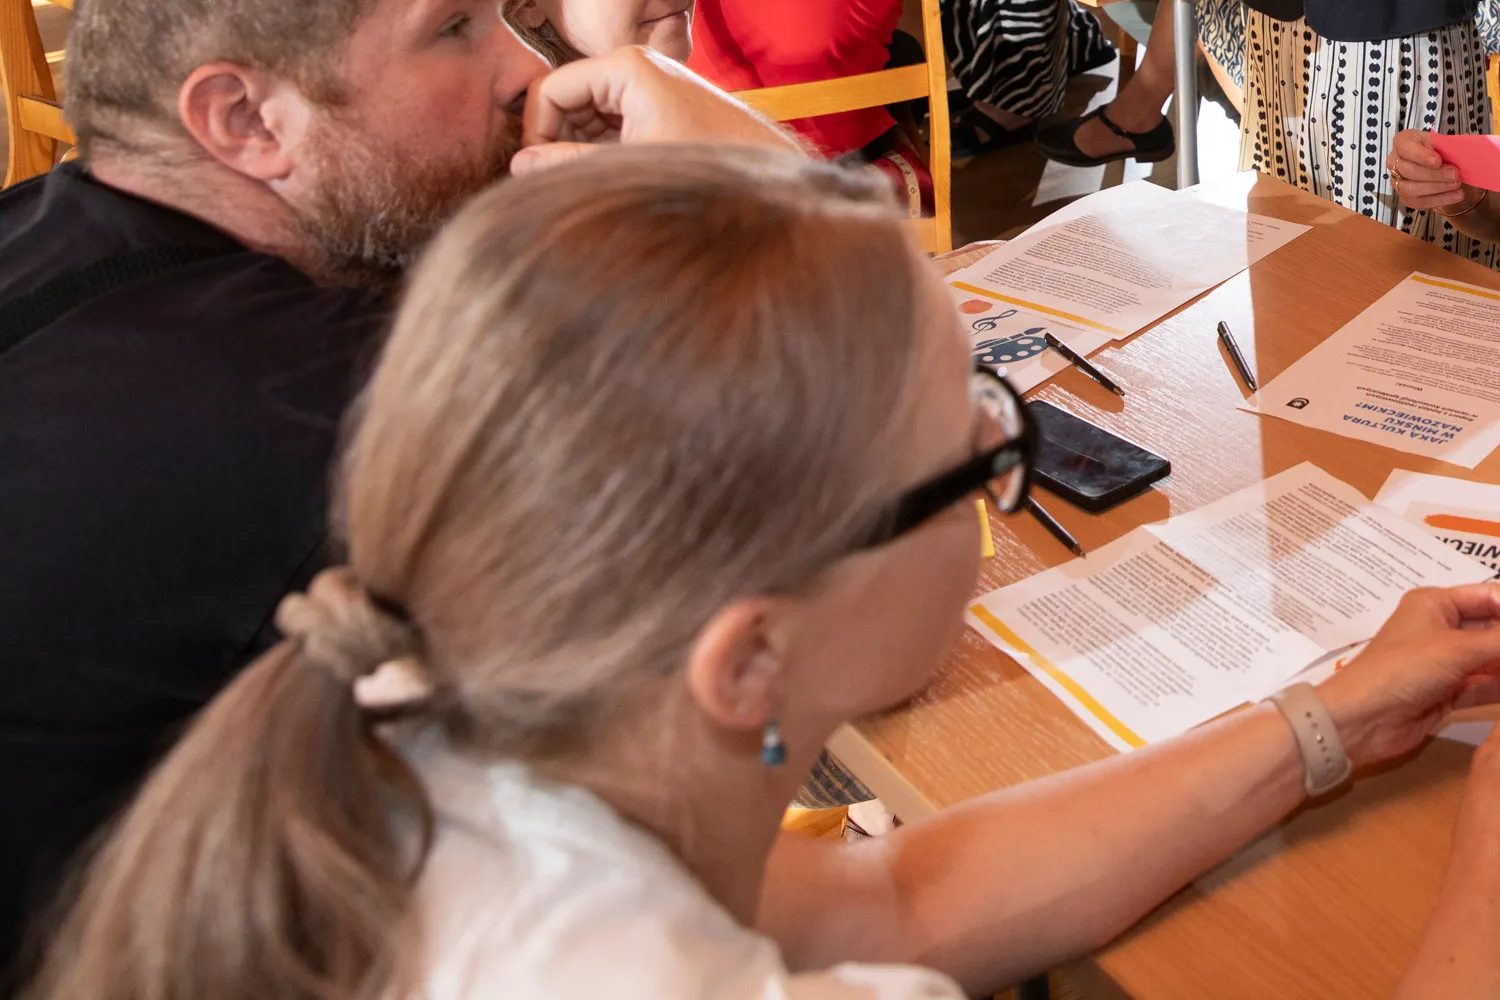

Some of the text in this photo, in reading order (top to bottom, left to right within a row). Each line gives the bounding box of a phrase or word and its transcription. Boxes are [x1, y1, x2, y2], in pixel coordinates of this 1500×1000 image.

[1342, 414, 1448, 444] JAKA KULTURA
[1355, 401, 1462, 432] MAZOWIECKIM?
[1384, 417, 1438, 435] MIŃSKU
